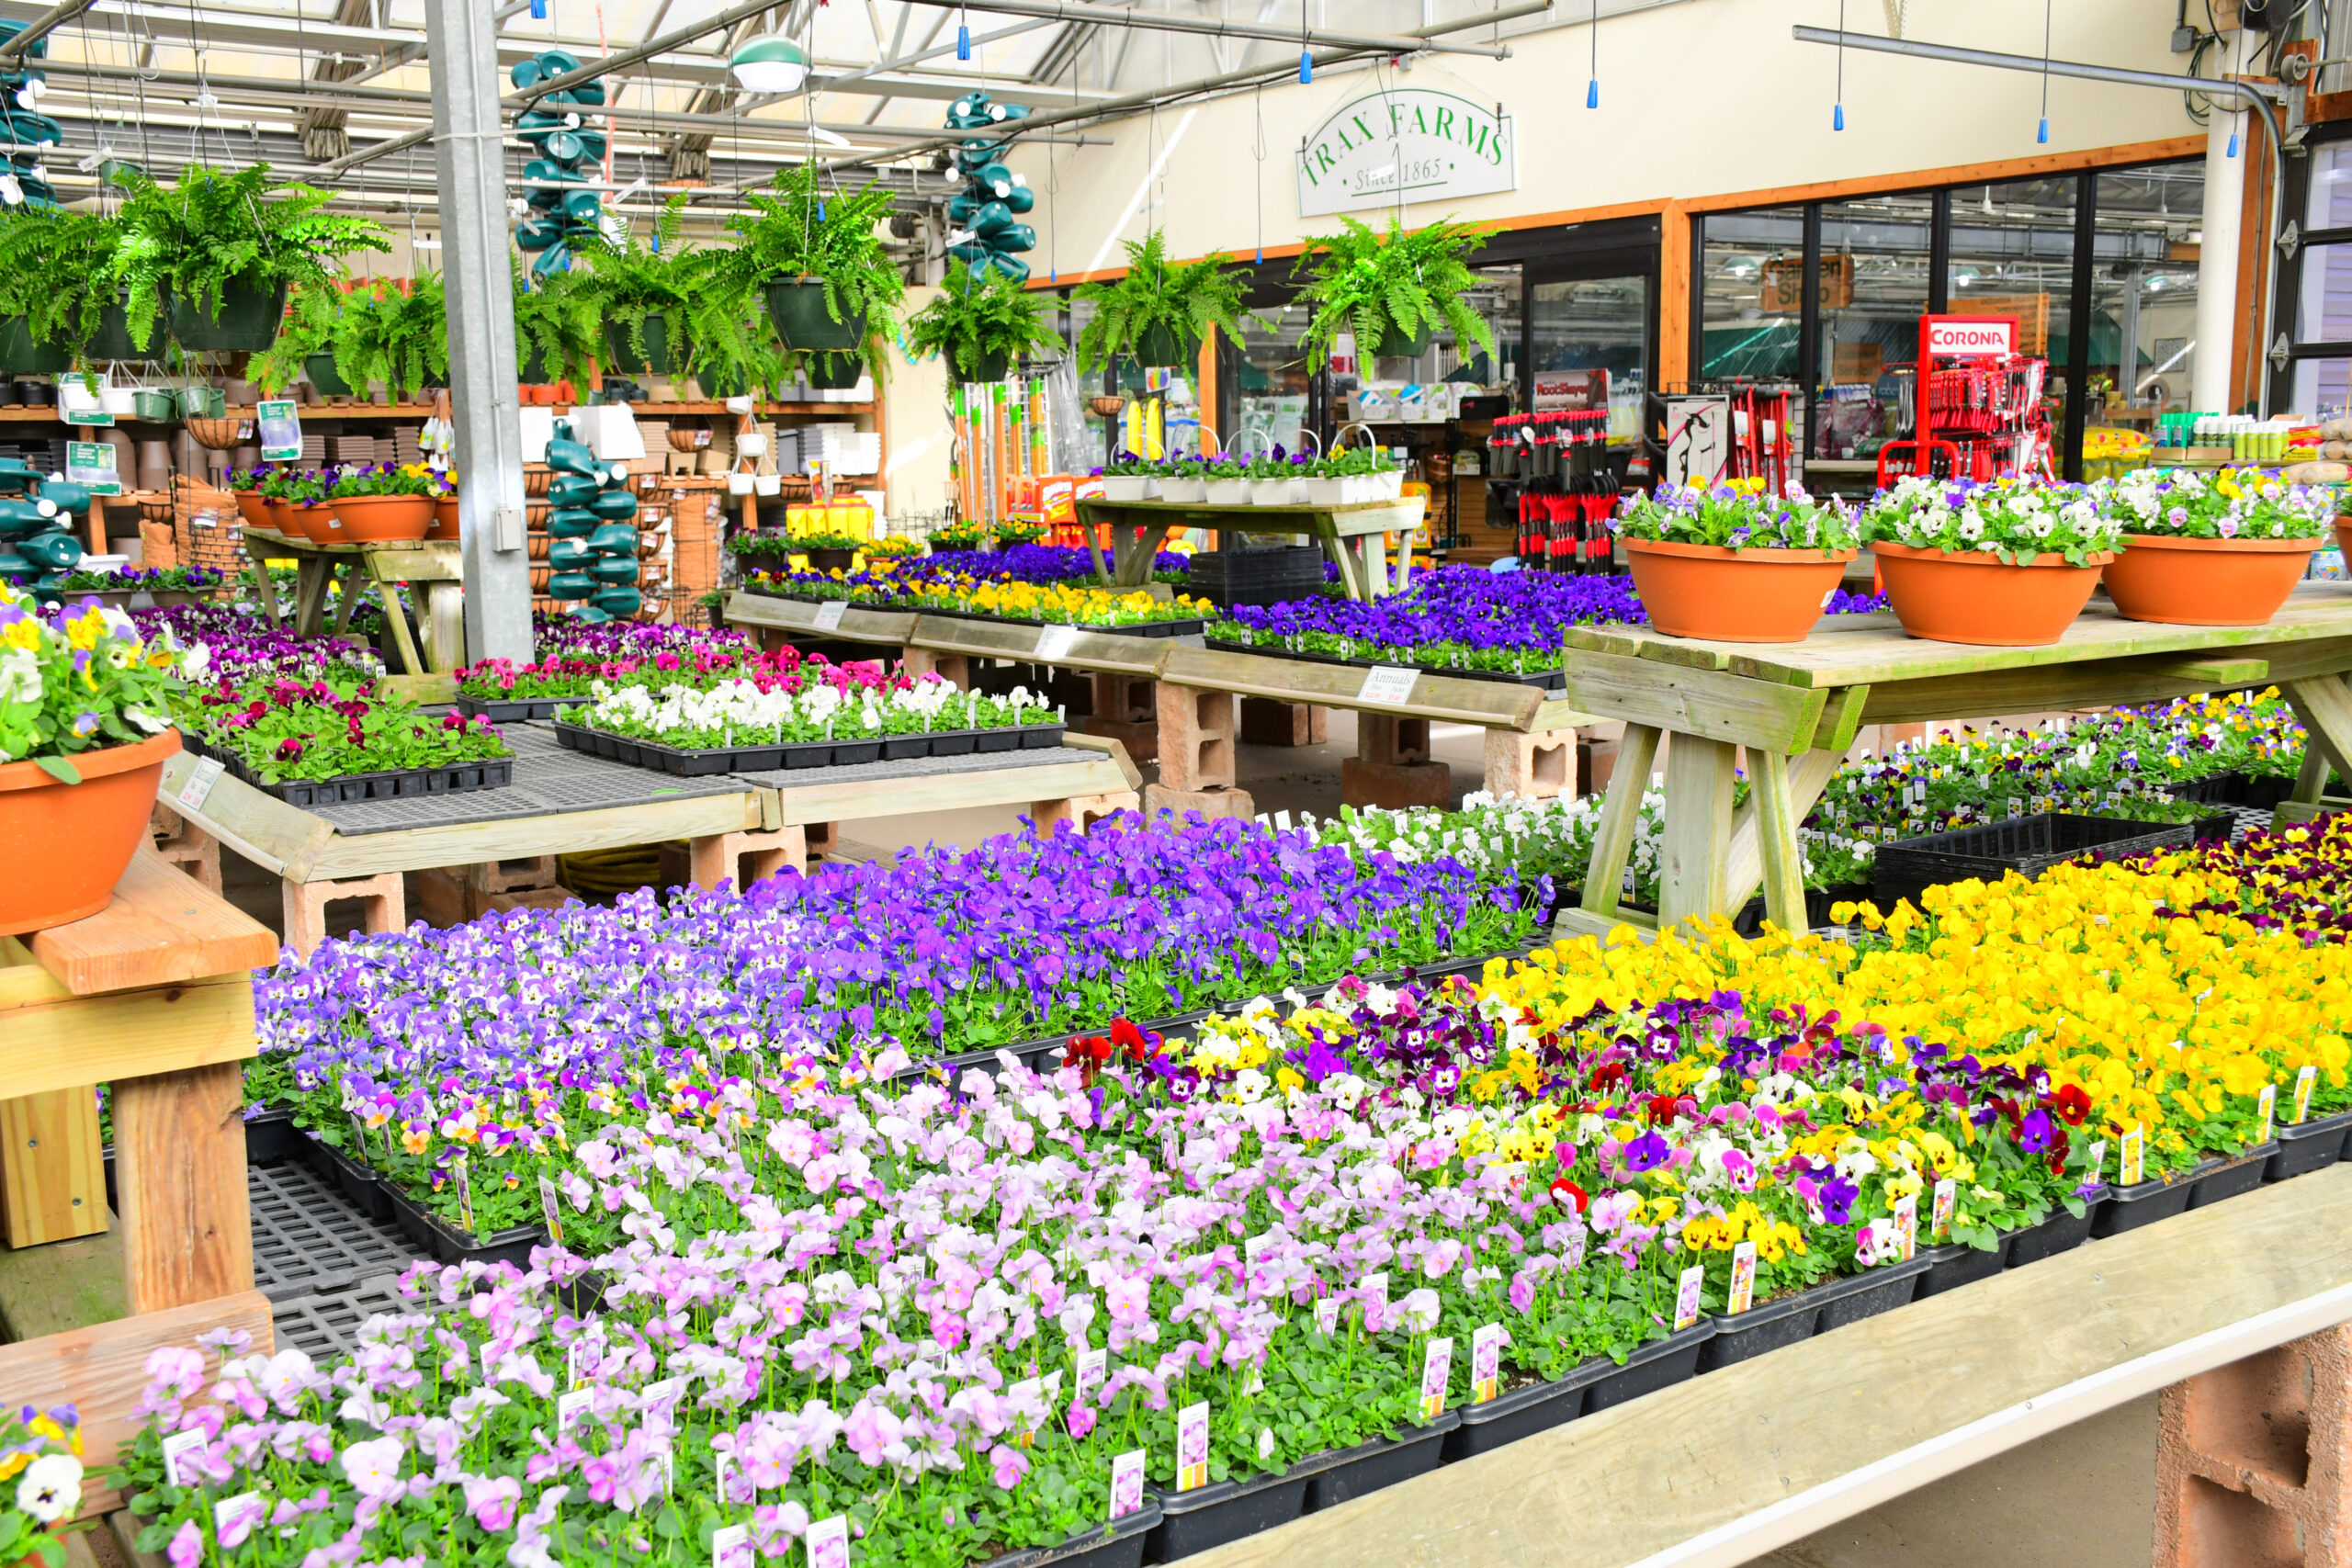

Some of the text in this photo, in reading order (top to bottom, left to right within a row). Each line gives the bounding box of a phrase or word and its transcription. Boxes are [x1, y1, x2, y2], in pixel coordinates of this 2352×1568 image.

[1301, 103, 1507, 187] TRAX FARMS
[1403, 158, 1441, 182] 1865
[1930, 329, 2004, 345] CORONA
[1371, 671, 1411, 685] Annuals
